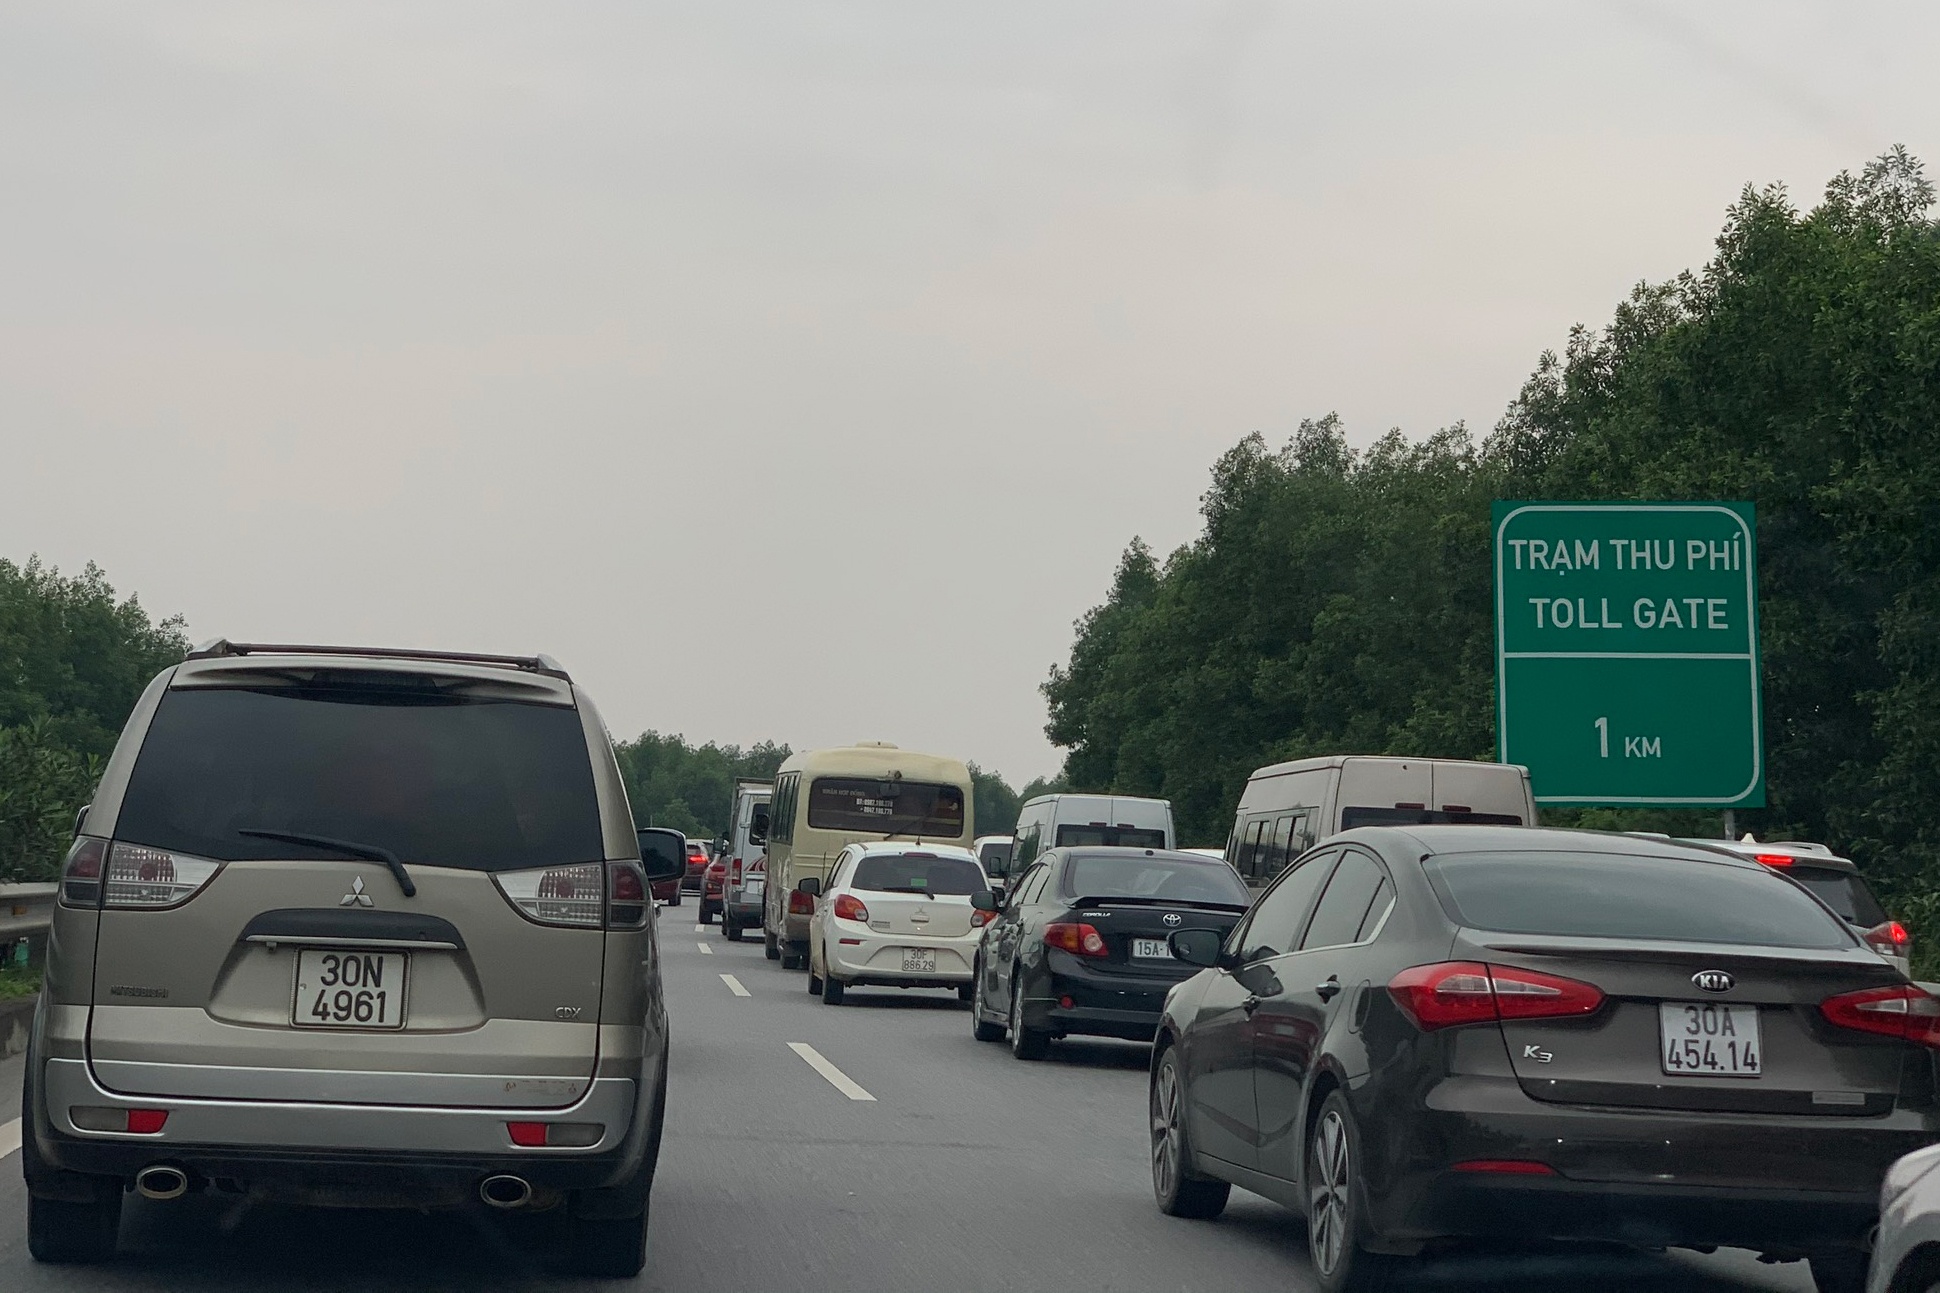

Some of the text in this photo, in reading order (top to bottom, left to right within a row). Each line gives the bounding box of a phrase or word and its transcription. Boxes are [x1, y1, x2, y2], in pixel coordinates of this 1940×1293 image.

[1508, 531, 1741, 576] TRẠM THU PHÍ
[1529, 598, 1728, 629] TOLL GATE
[1594, 717, 1661, 758] 1 KM
[911, 949, 927, 960] 30F
[320, 954, 384, 988] 30N
[1700, 975, 1731, 989] KIA
[311, 989, 386, 1023] 4961
[1684, 1005, 1736, 1037] 30A
[1523, 1045, 1553, 1063] K3
[1668, 1038, 1758, 1071] 454.14
